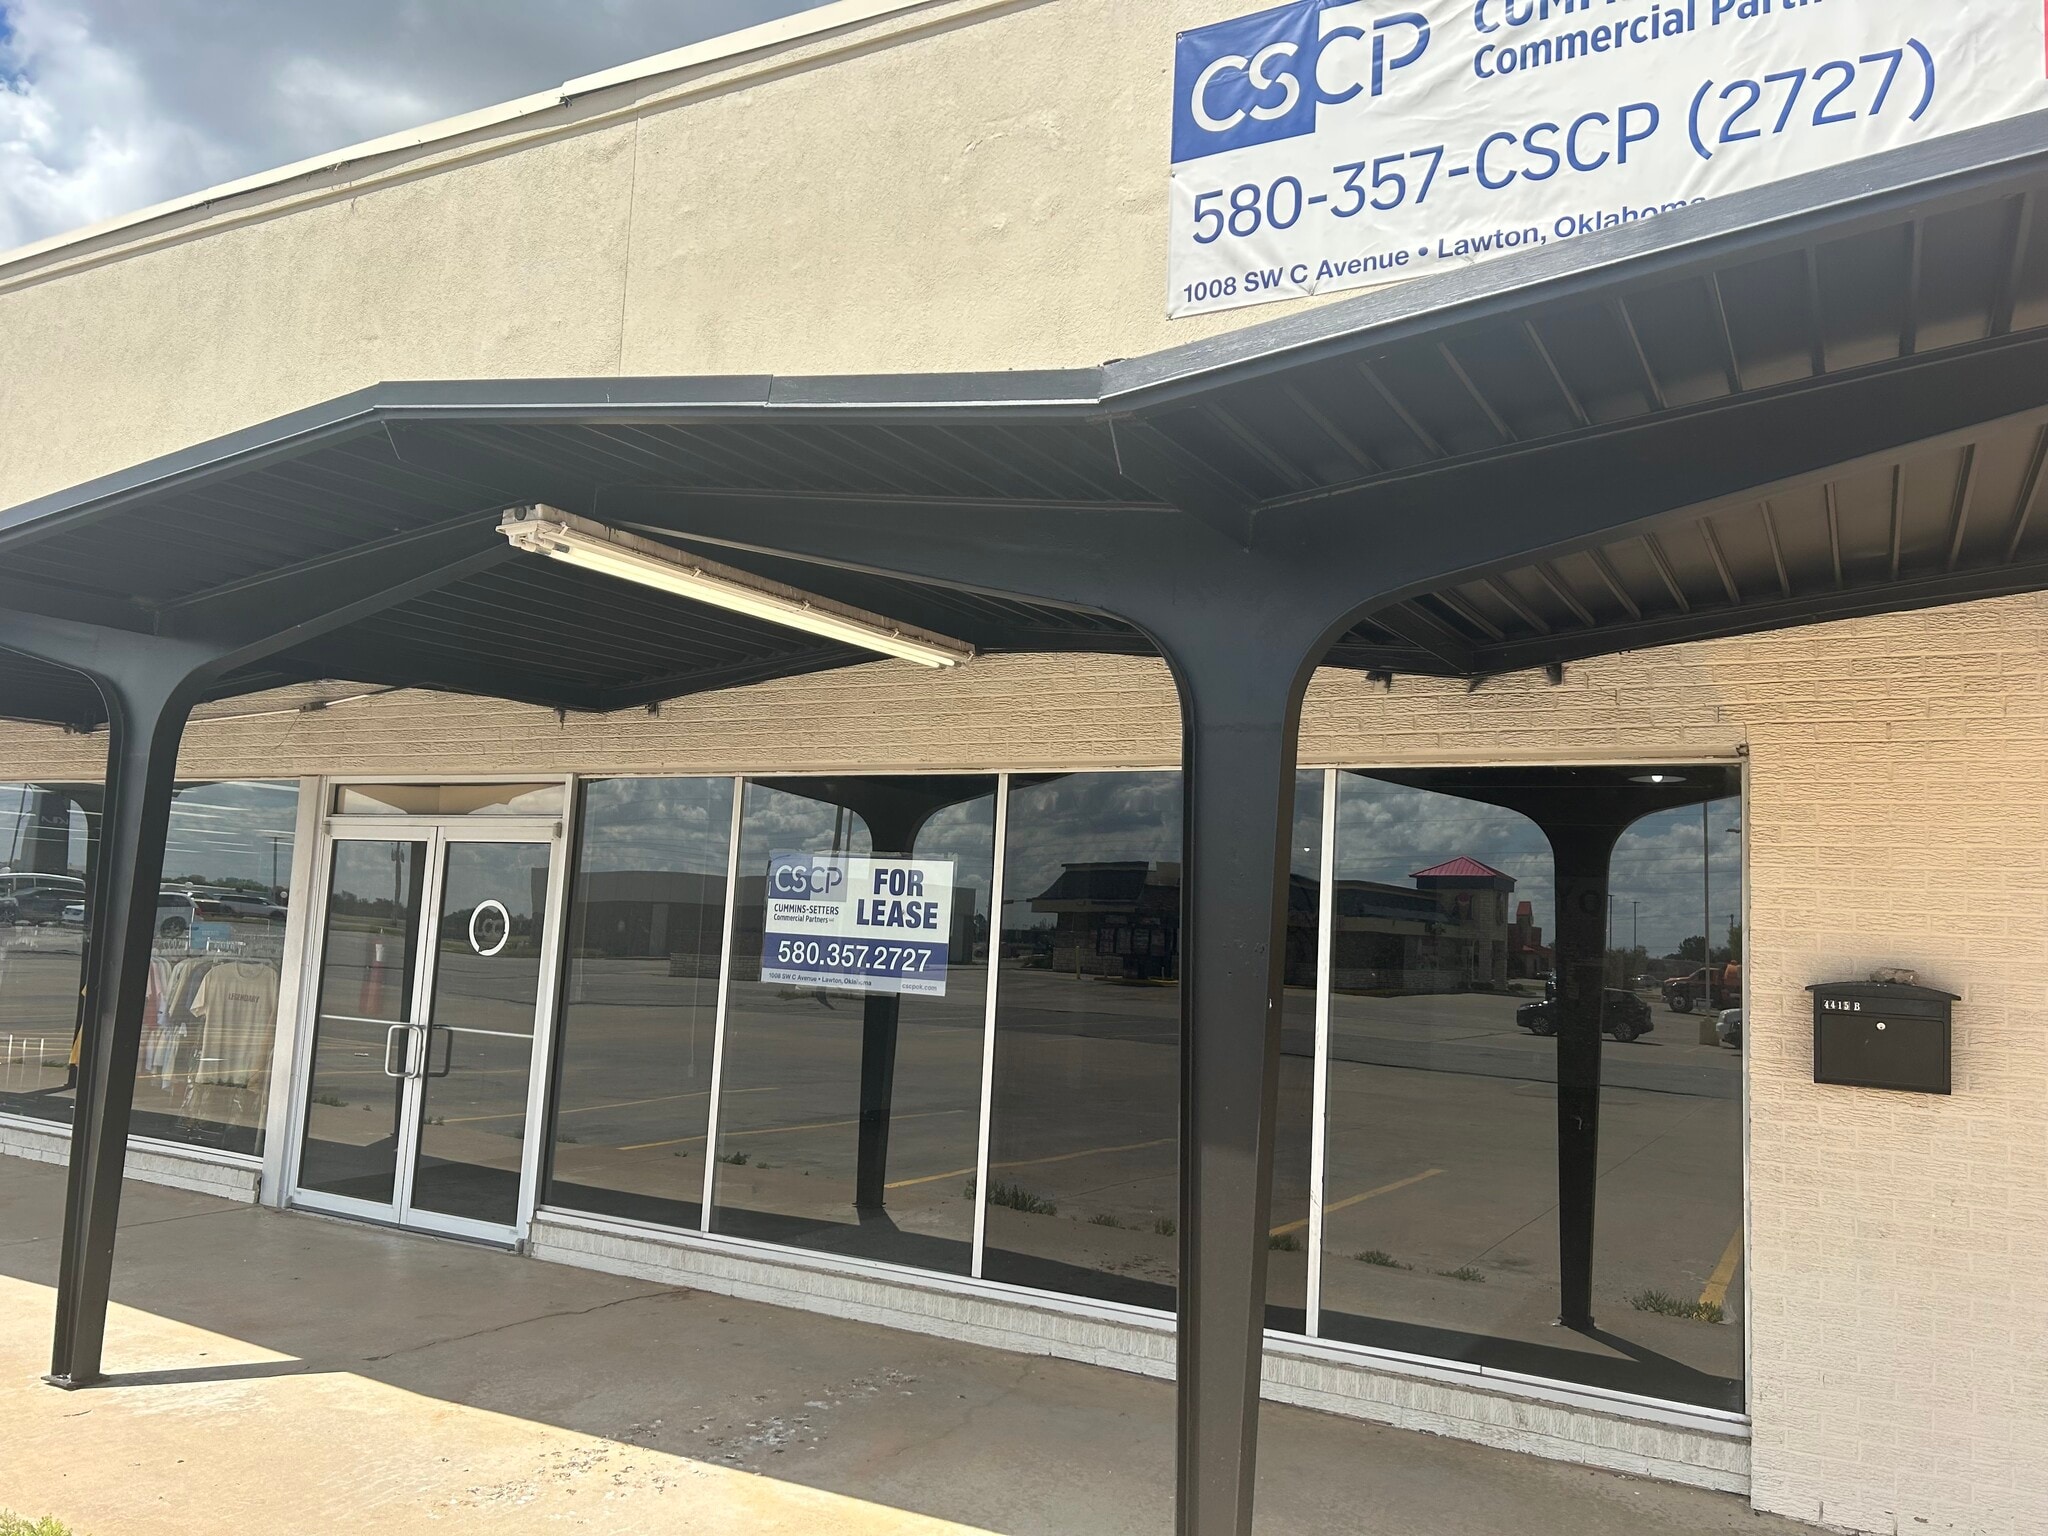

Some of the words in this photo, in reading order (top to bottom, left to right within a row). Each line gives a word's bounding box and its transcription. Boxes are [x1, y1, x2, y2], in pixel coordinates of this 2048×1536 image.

[1474, 0, 1695, 78] Commercial
[1191, 12, 1430, 132] CSCP
[1193, 102, 1660, 244] 580-357-CSCP
[1688, 37, 1936, 161] (2727)
[1184, 276, 1237, 302] 1008
[1244, 267, 1284, 292] SW
[1290, 264, 1309, 284] C
[1316, 250, 1410, 281] Avenue
[1438, 225, 1547, 258] Lawton,
[1554, 197, 1706, 238] Oklaho
[775, 865, 843, 893] CSCP
[873, 868, 924, 897] FOR
[773, 913, 804, 922] Commercial
[805, 915, 828, 924] Partners
[774, 903, 839, 915] CUMMINS-SETTERS
[856, 898, 938, 930] LEASE
[778, 940, 931, 972] 580.357.2727
[798, 974, 817, 982] Avenue
[902, 983, 937, 992] cscpok.com
[1824, 1000, 1850, 1010] 4415
[1854, 1002, 1861, 1011] B
